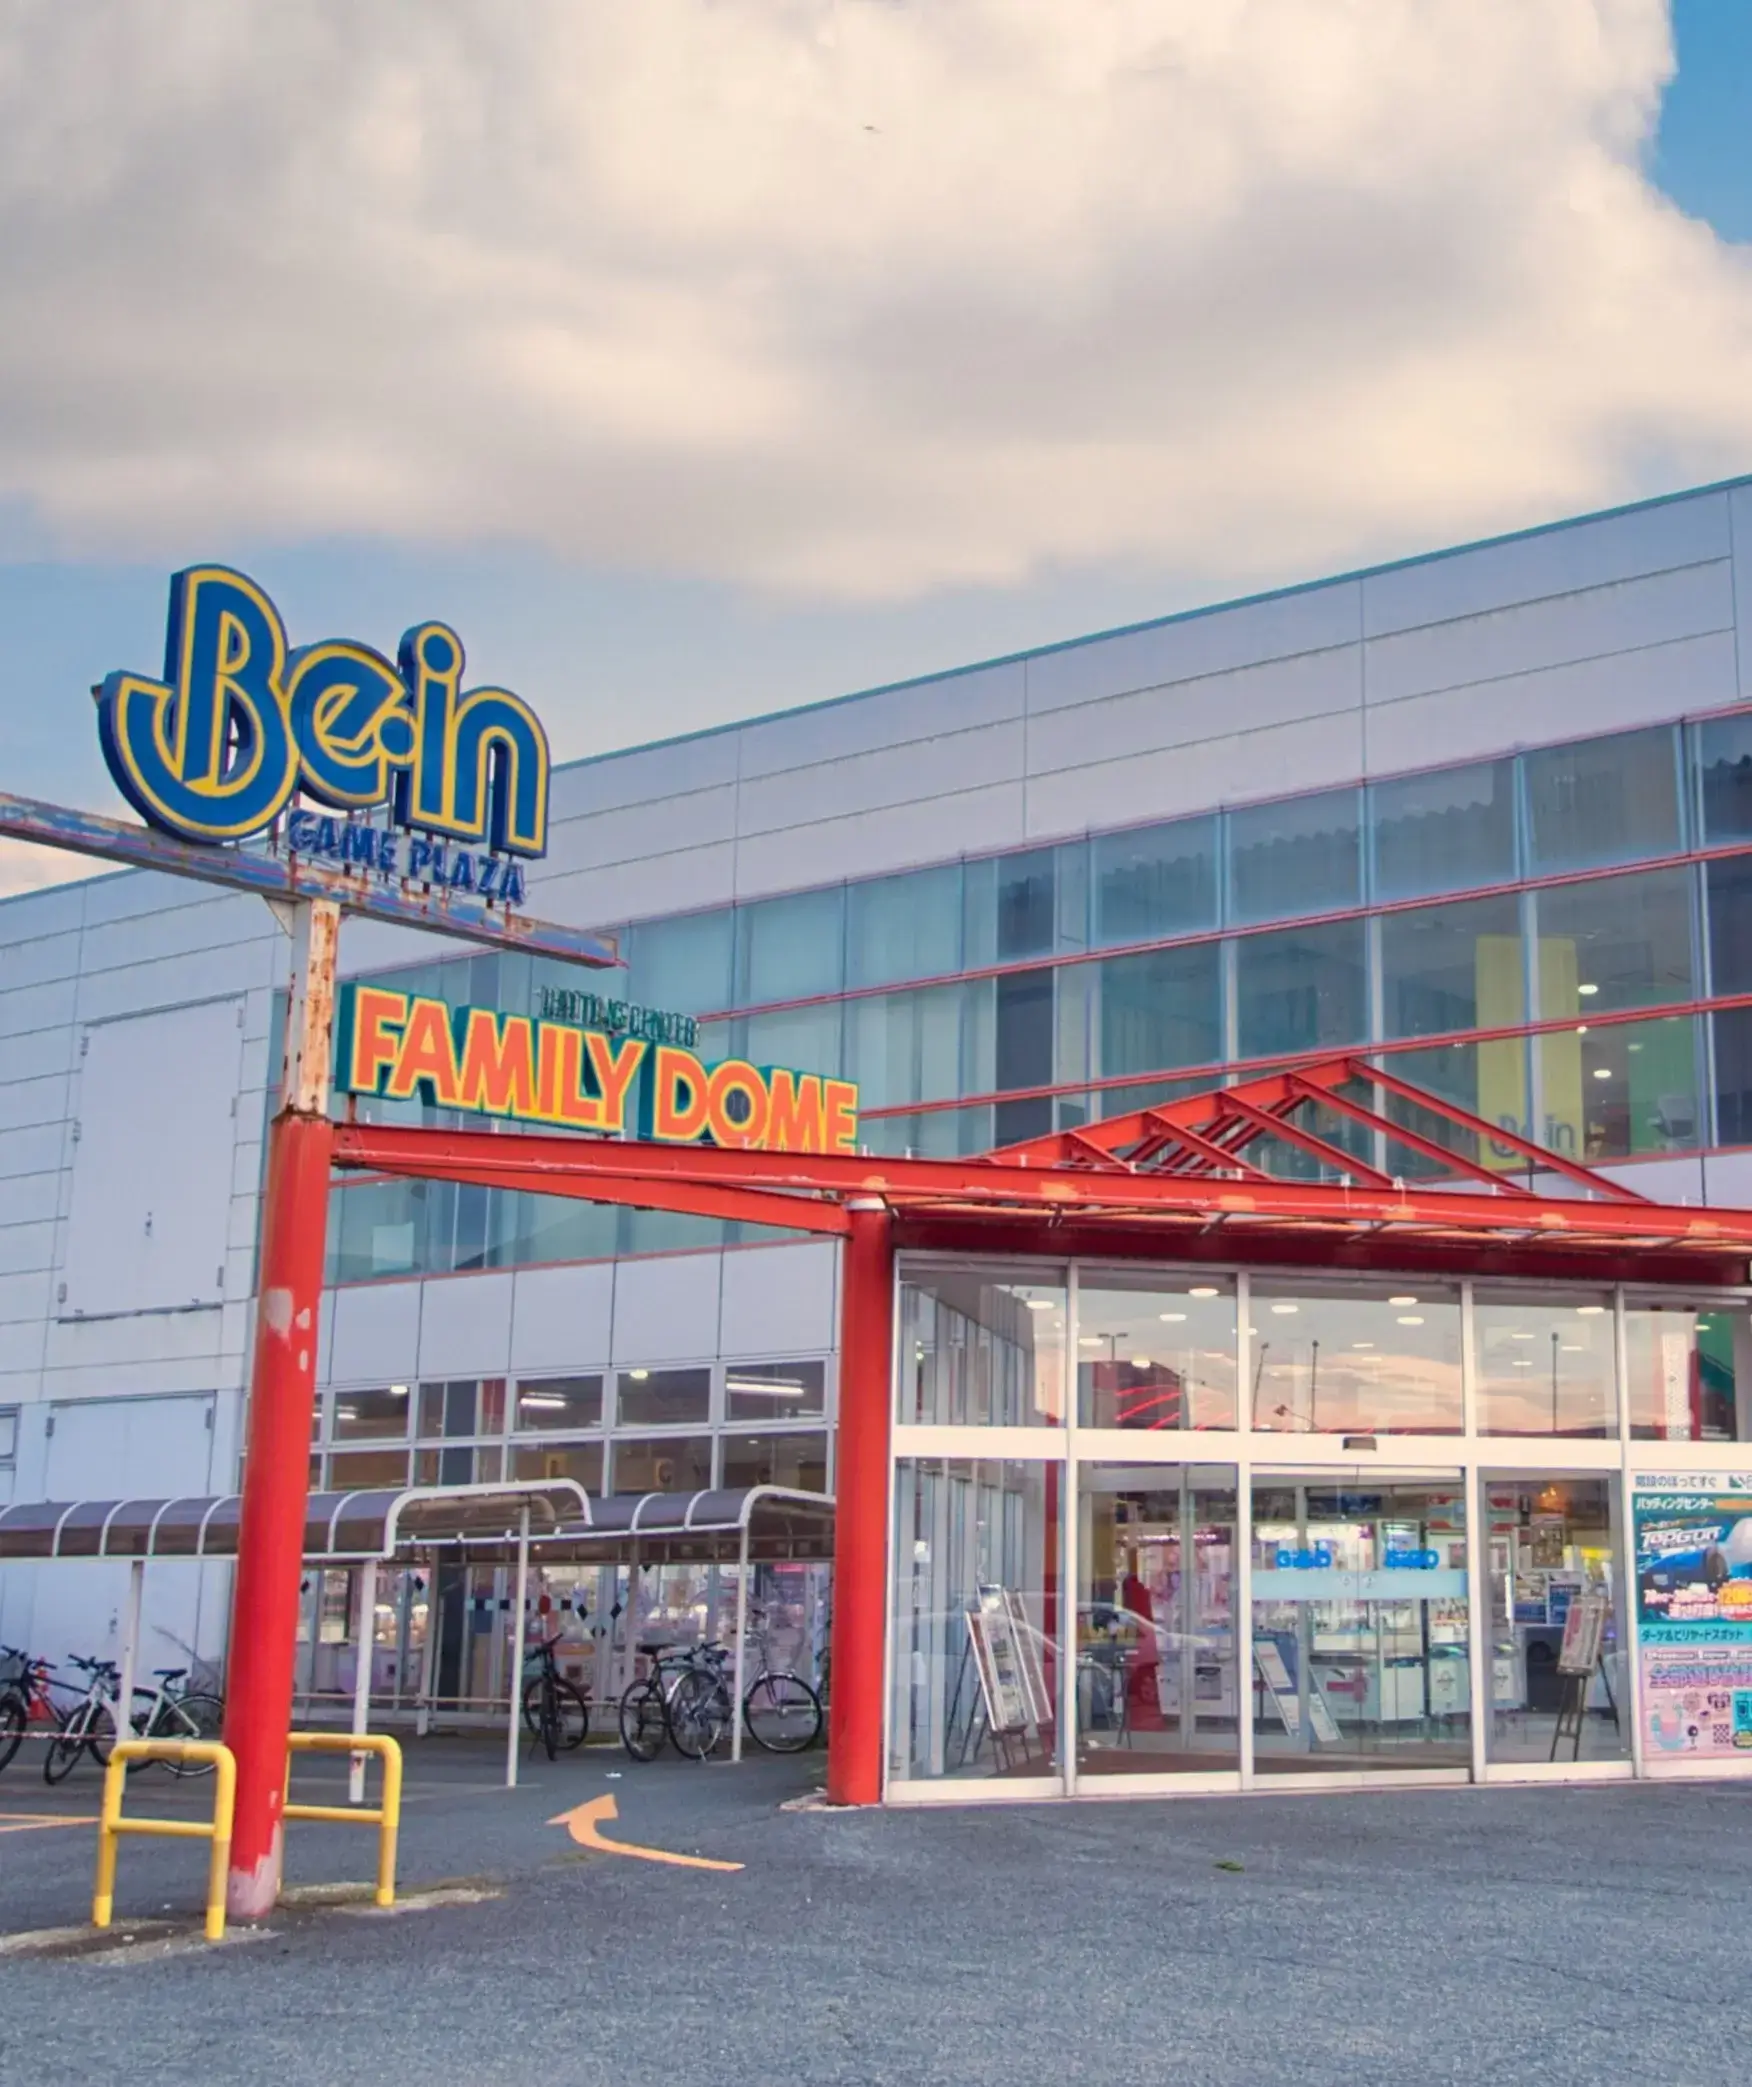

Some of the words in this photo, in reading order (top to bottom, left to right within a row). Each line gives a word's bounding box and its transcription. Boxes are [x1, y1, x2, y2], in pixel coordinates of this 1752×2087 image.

[288, 808, 398, 873] GAME
[409, 837, 526, 906] PLAZA
[338, 983, 648, 1133] FAMILY
[645, 1044, 859, 1156] DOME
[1636, 1497, 1714, 1510] バッティングセンター
